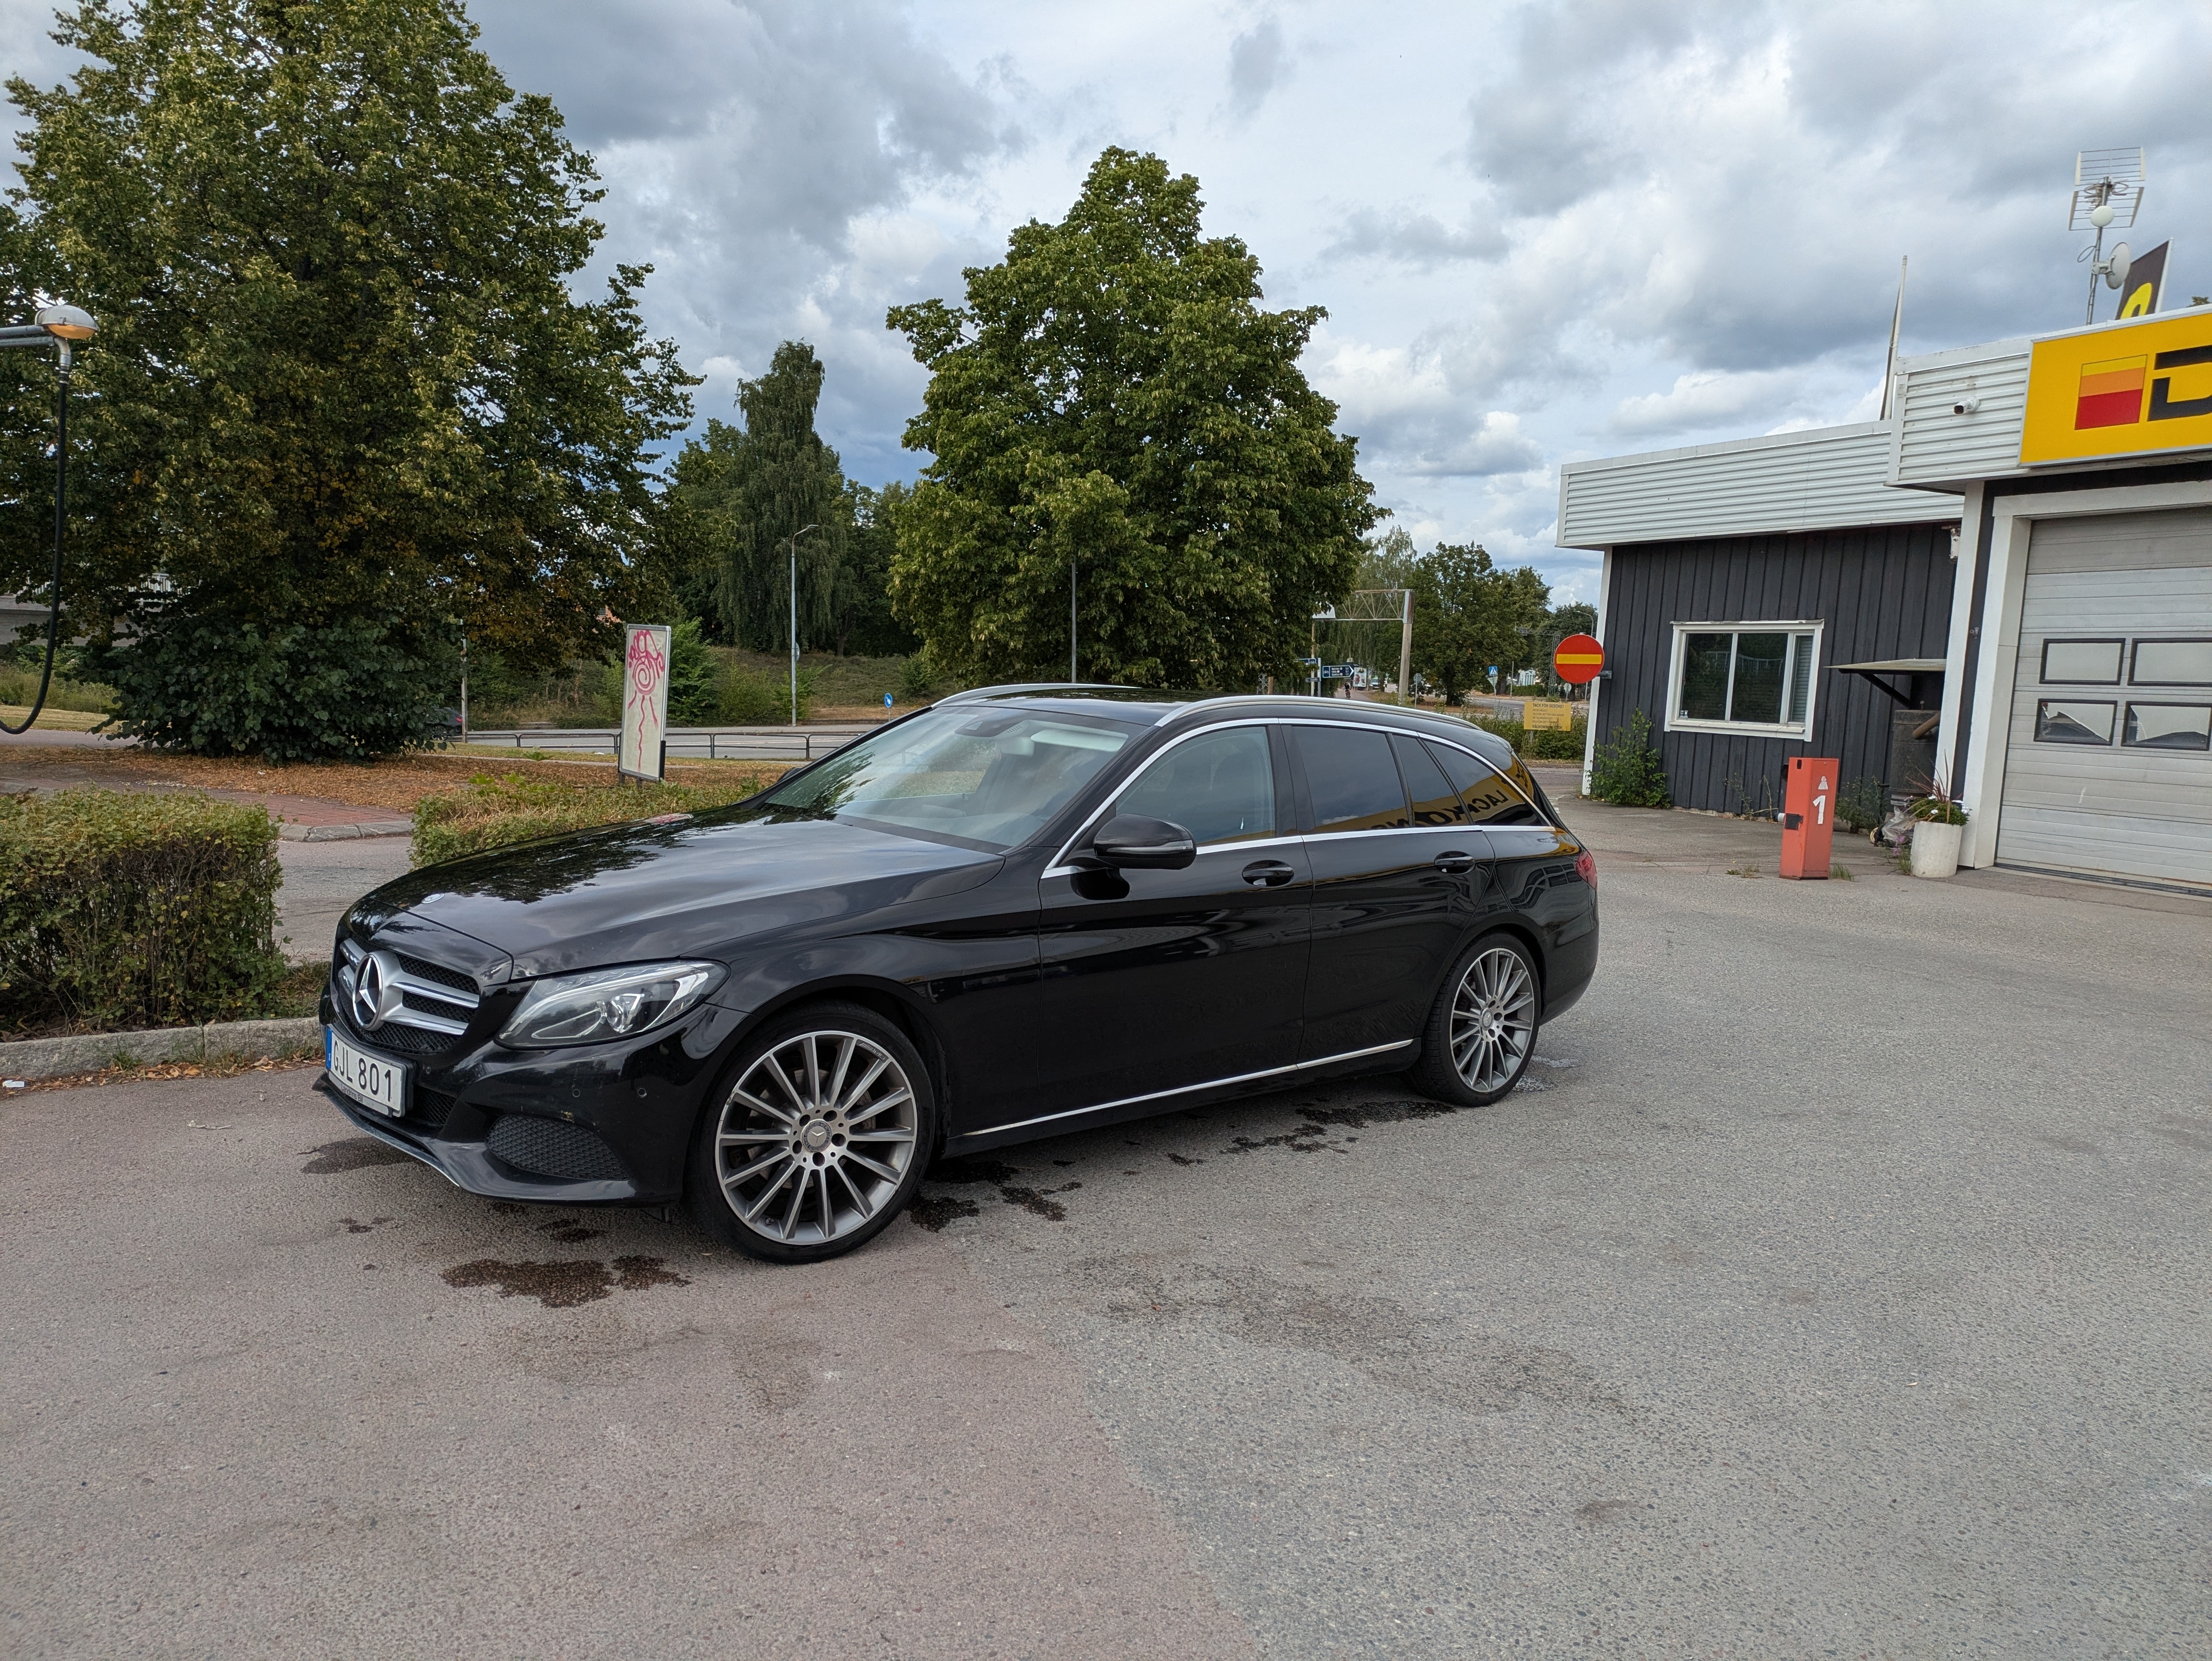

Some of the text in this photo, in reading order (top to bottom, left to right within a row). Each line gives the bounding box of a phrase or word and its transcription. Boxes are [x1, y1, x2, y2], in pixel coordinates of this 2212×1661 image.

[1813, 795, 1825, 824] 1
[334, 1040, 391, 1102] GJL 801
